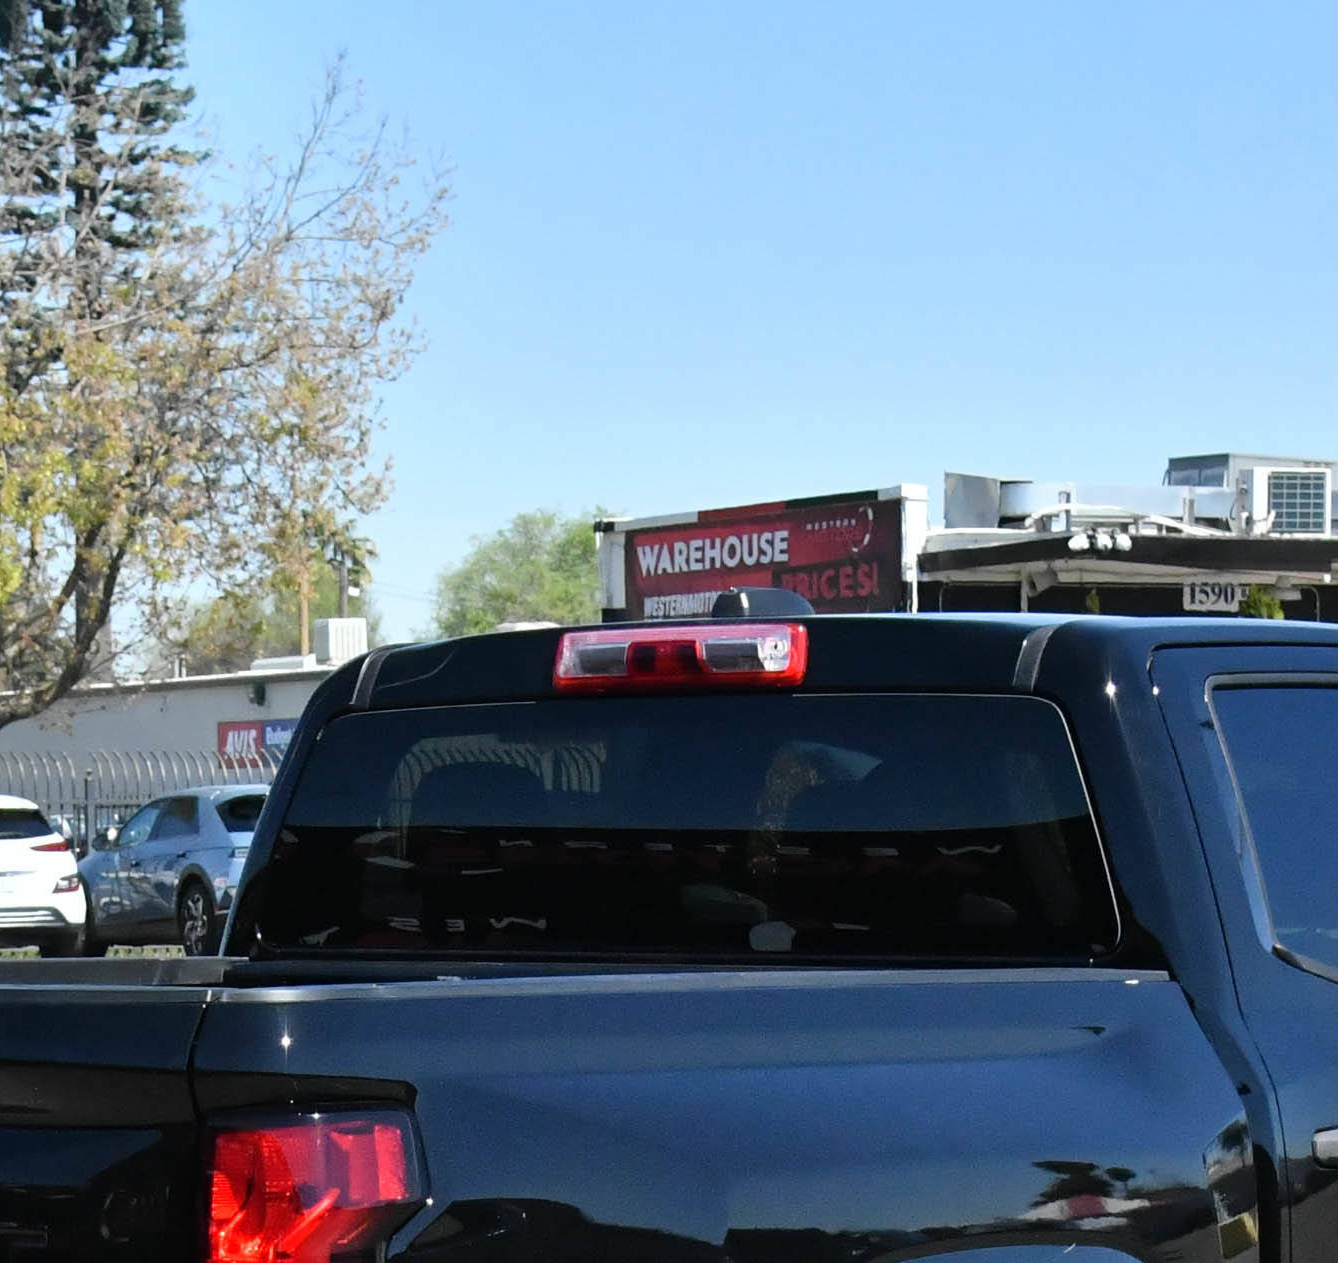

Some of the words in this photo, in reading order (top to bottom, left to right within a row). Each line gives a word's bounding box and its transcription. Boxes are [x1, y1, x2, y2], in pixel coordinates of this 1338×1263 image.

[636, 529, 790, 578] WAREHOUSE
[1189, 582, 1236, 606] 1590
[224, 728, 258, 760] AVIS
